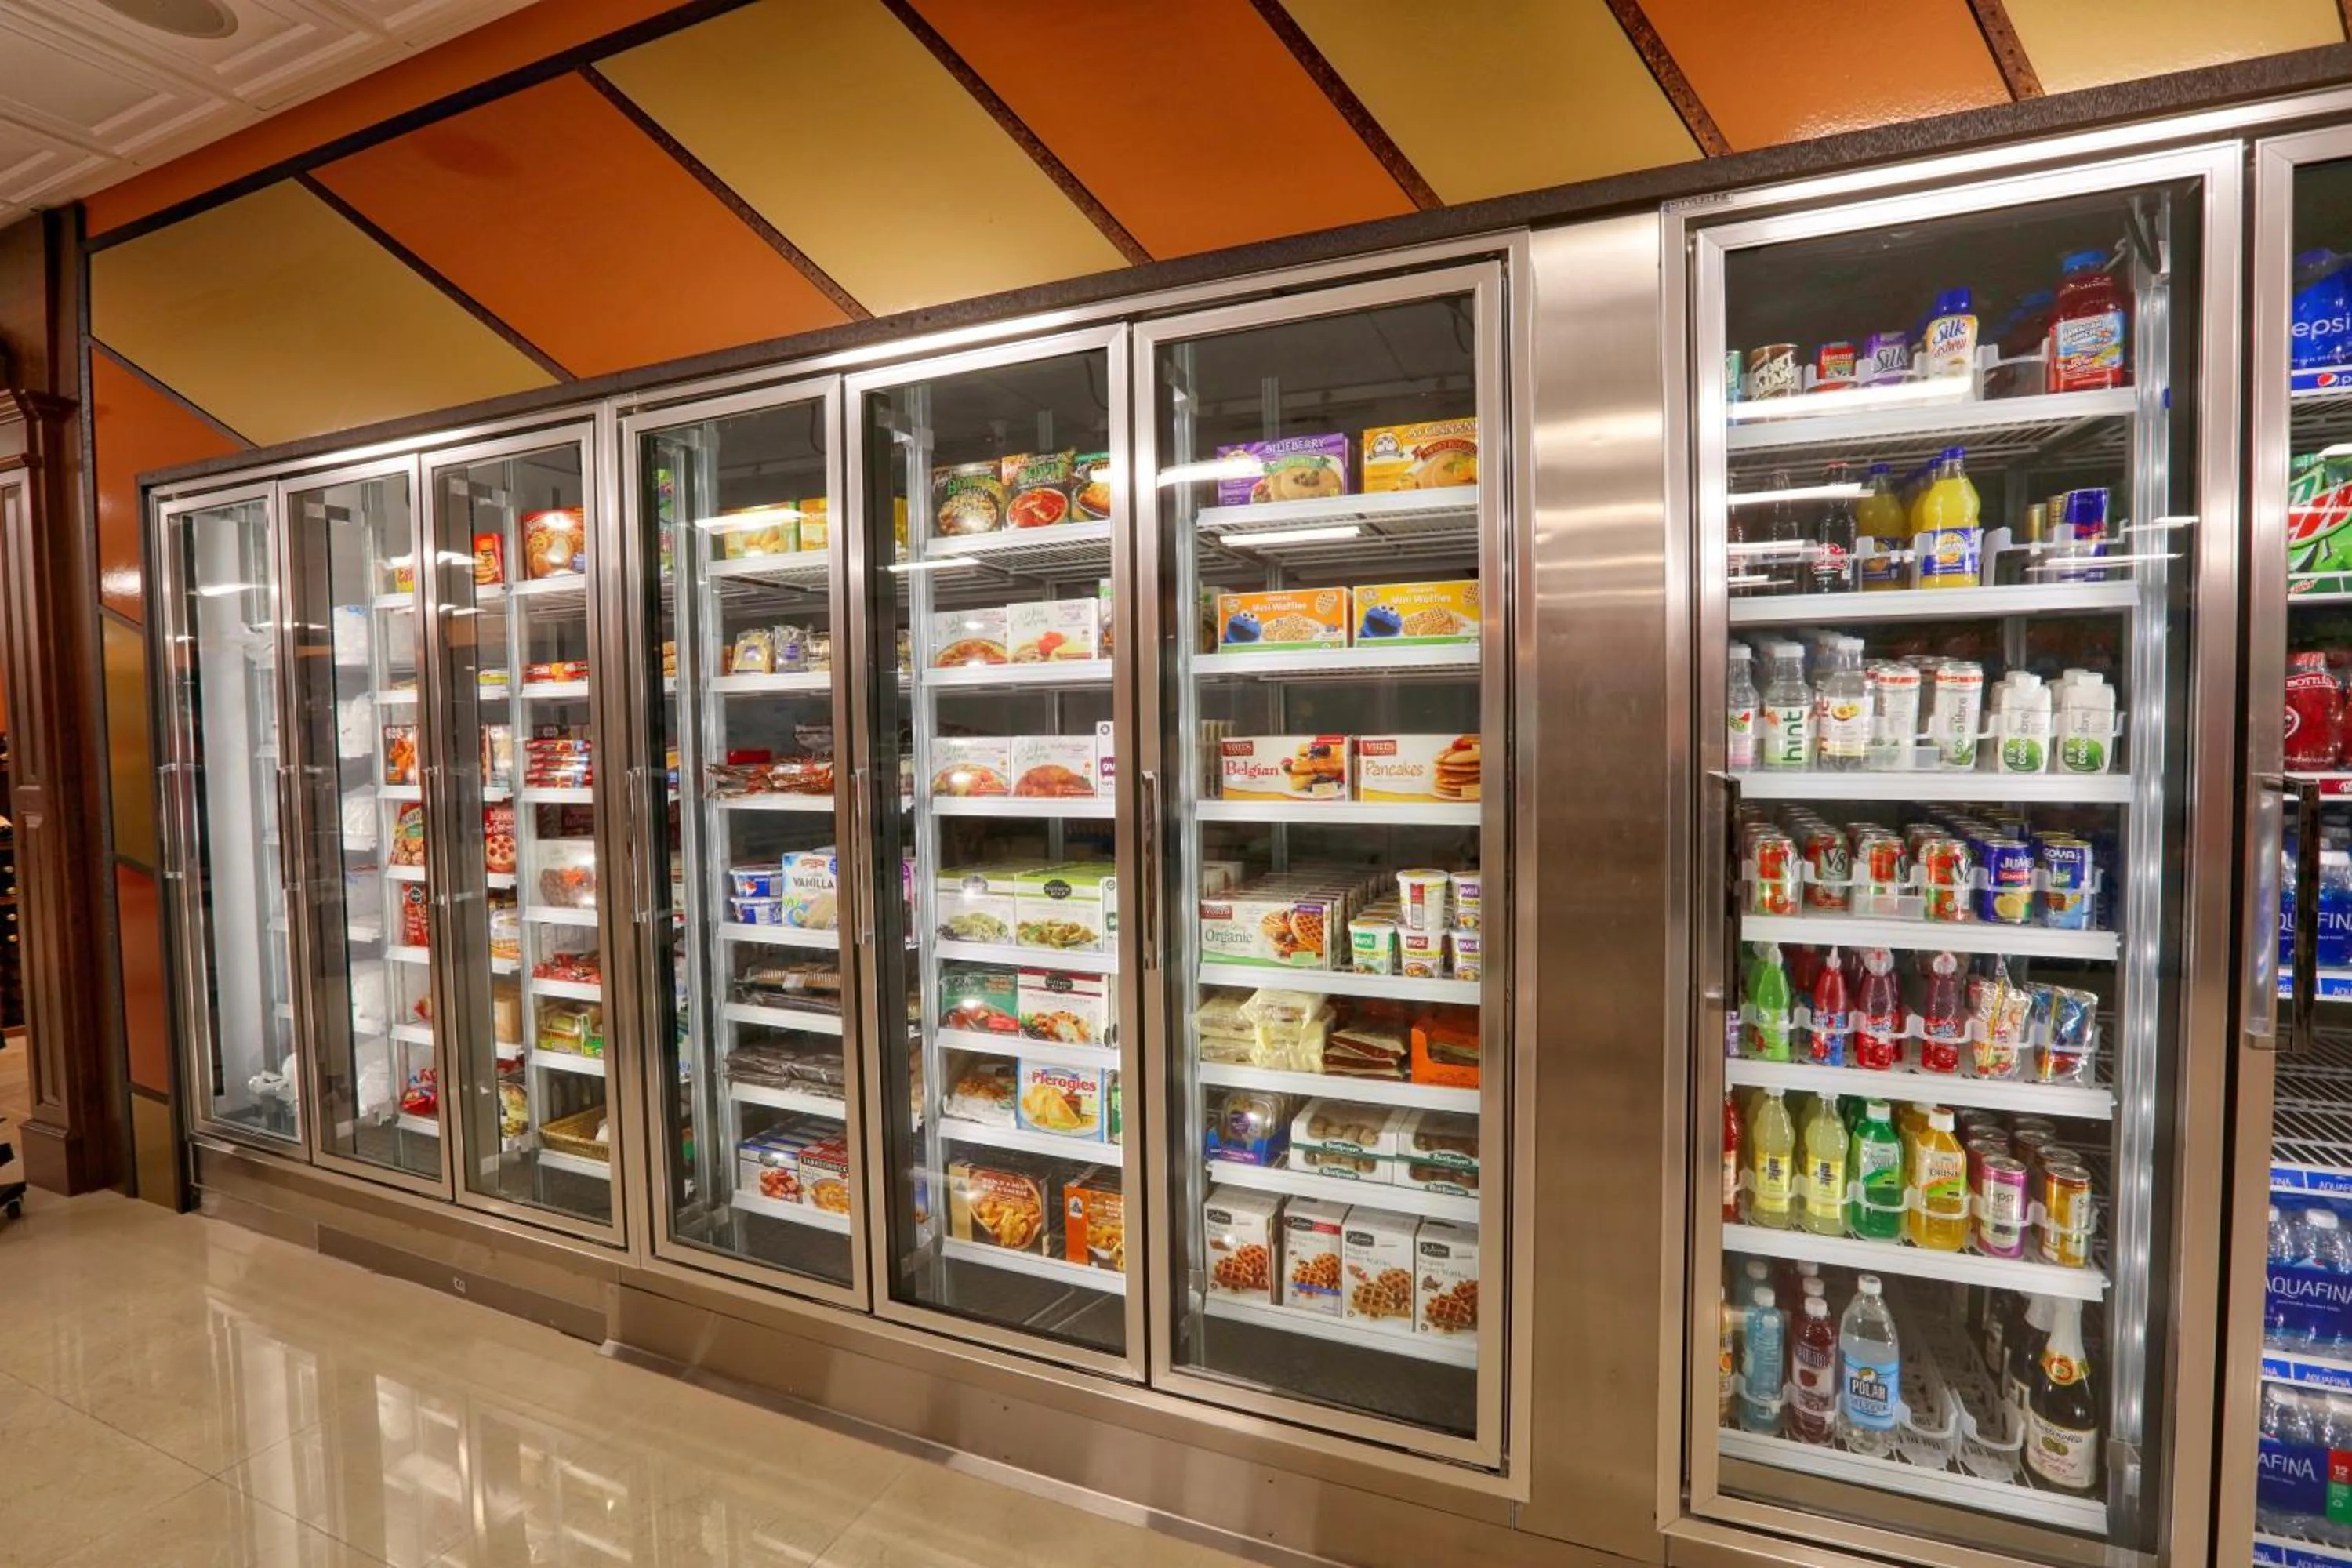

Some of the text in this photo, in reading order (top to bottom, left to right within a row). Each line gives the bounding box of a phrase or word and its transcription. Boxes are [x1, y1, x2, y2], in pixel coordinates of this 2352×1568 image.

[1933, 318, 1966, 344] Silk
[2292, 313, 2351, 340] epsi
[1874, 344, 1907, 373] Silk
[1265, 438, 1325, 454] BLUEBERRY
[1782, 710, 1804, 762] hint
[1225, 760, 1279, 779] Belgian
[1364, 759, 1424, 777] Pancakes
[1823, 848, 1846, 873] V8
[793, 877, 835, 889] VANILLA
[1204, 928, 1253, 946] Organic
[1031, 1069, 1097, 1095] Pierogies
[1852, 1378, 1886, 1399] POLAR
[2305, 1371, 2350, 1388] AQUAFINA
[2258, 1452, 2315, 1481] AFINA
